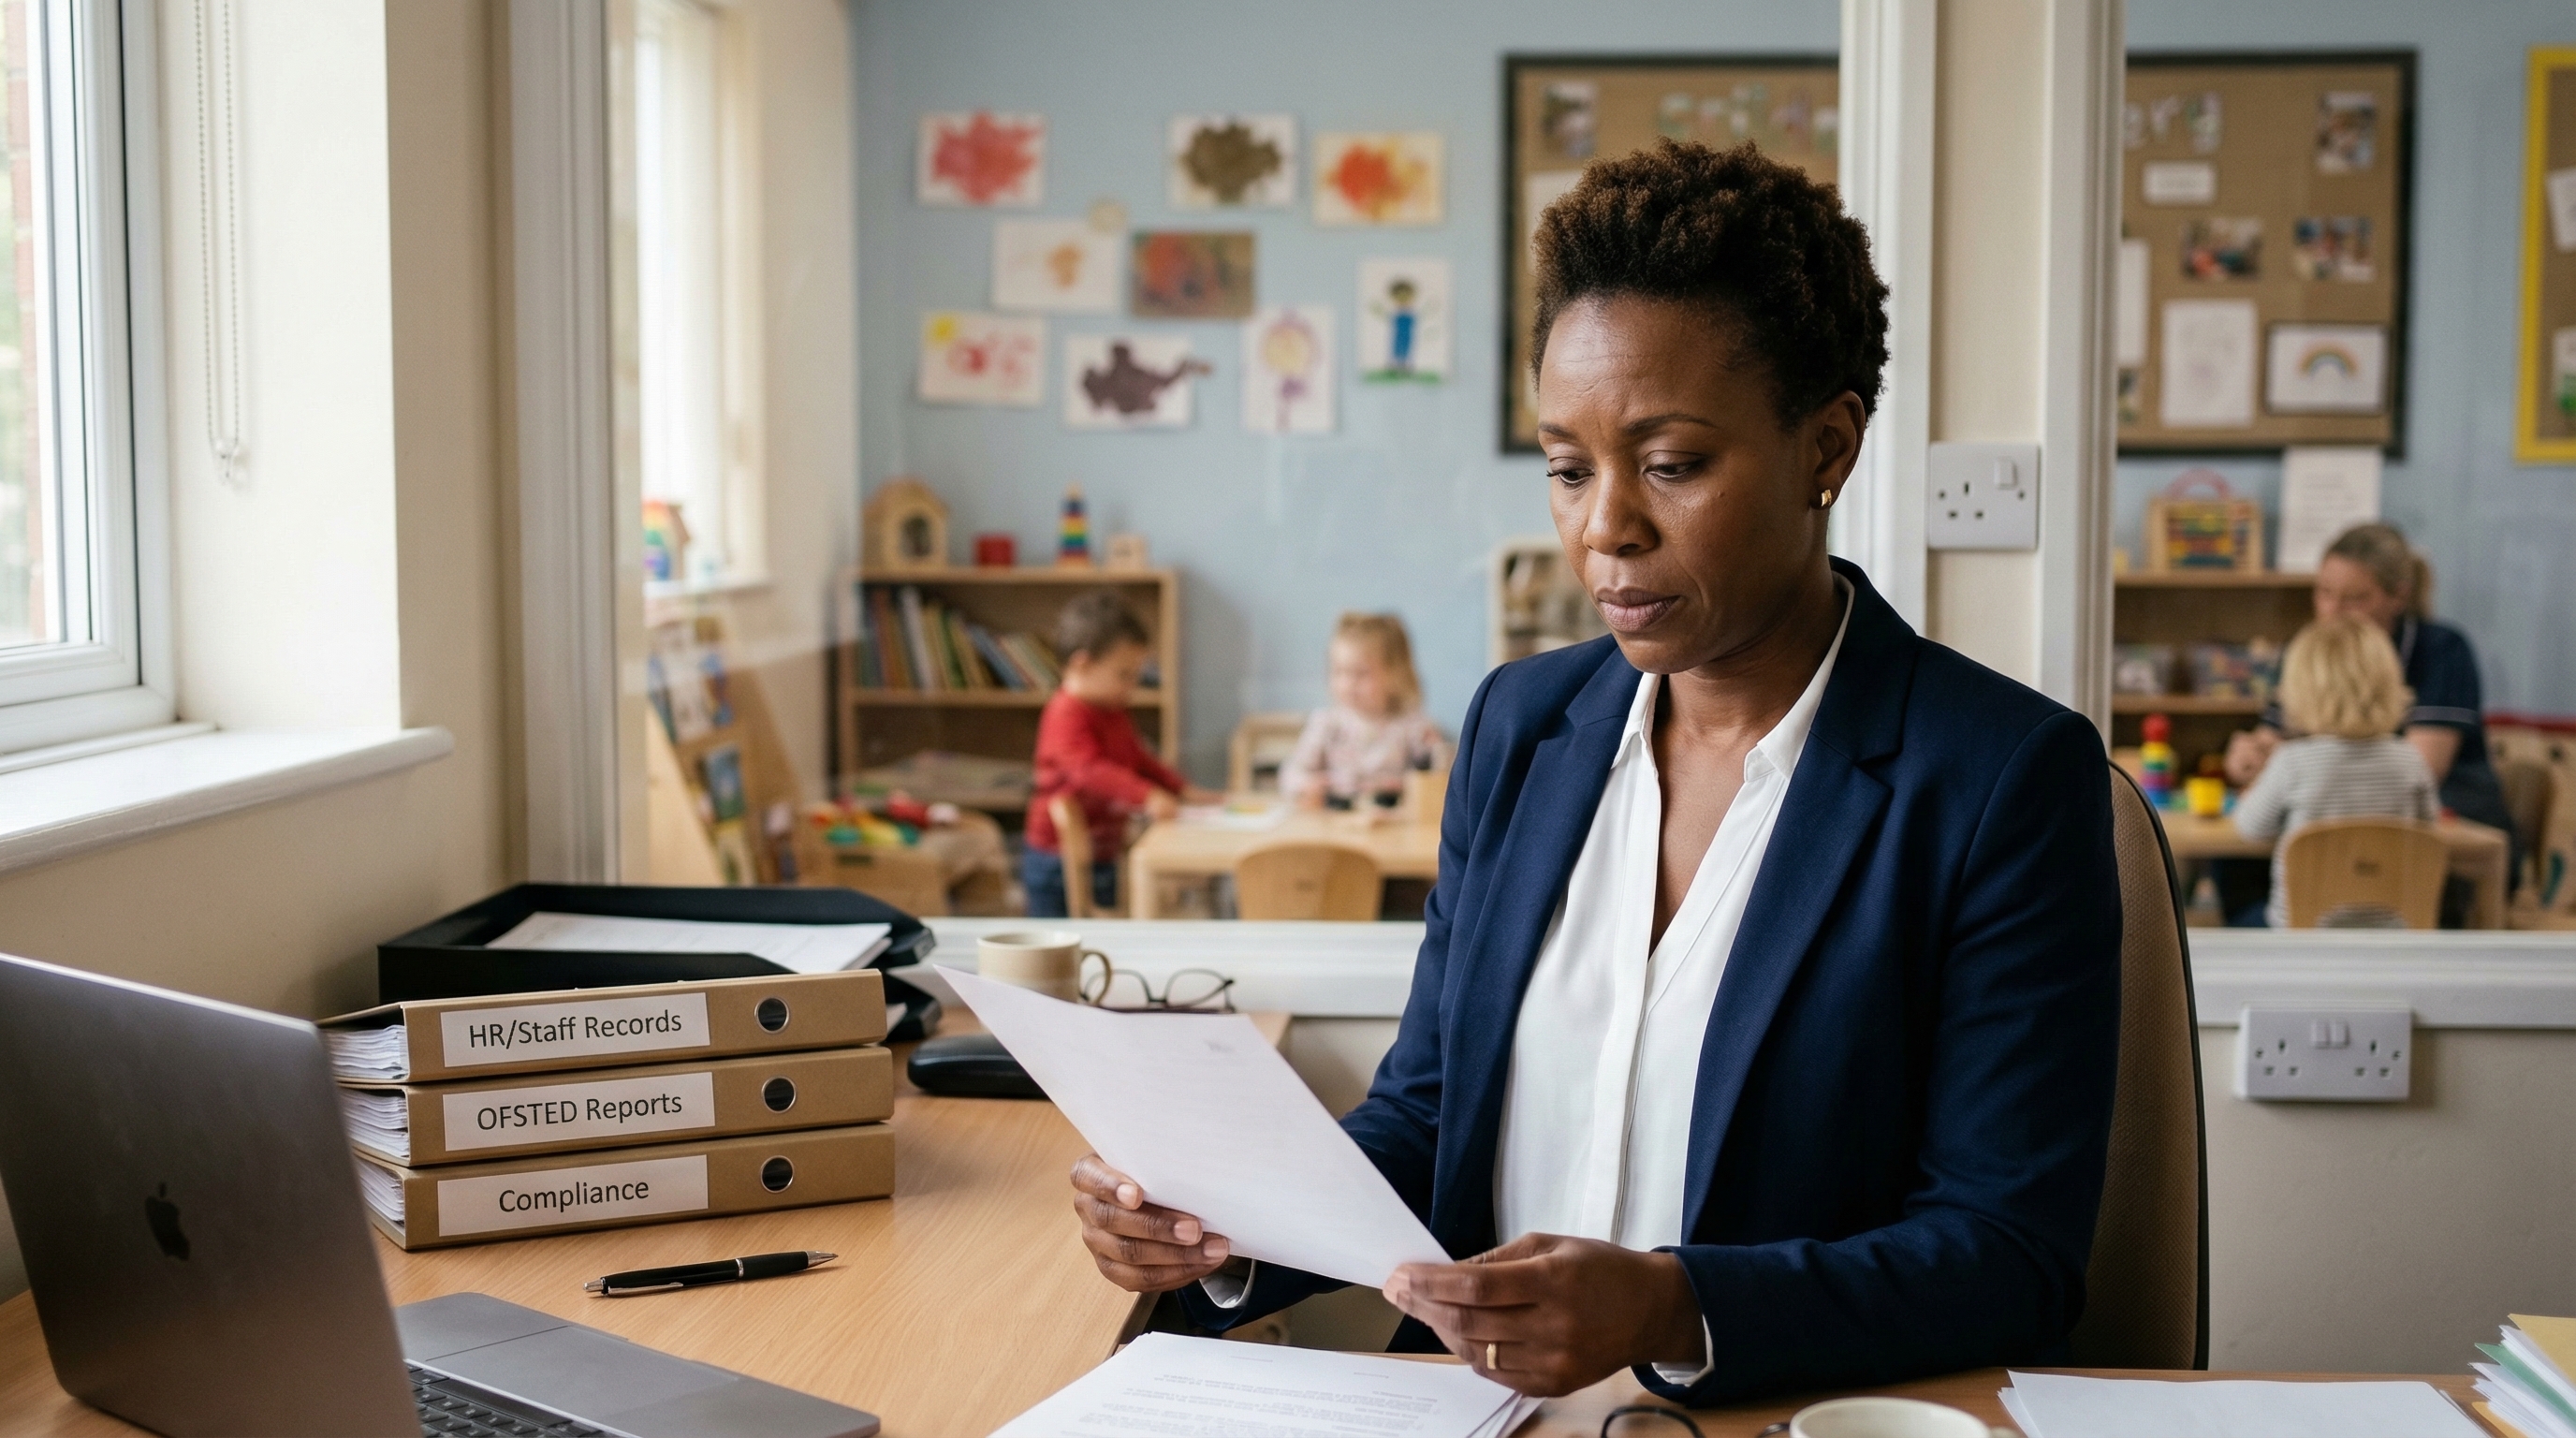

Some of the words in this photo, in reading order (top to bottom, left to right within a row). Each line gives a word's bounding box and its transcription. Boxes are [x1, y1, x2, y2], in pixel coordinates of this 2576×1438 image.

[469, 1016, 578, 1050] HR/Staff
[584, 1008, 682, 1039] Records
[476, 1100, 578, 1131] OFSTED
[586, 1093, 682, 1124] Reports
[498, 1181, 650, 1213] Compliance
